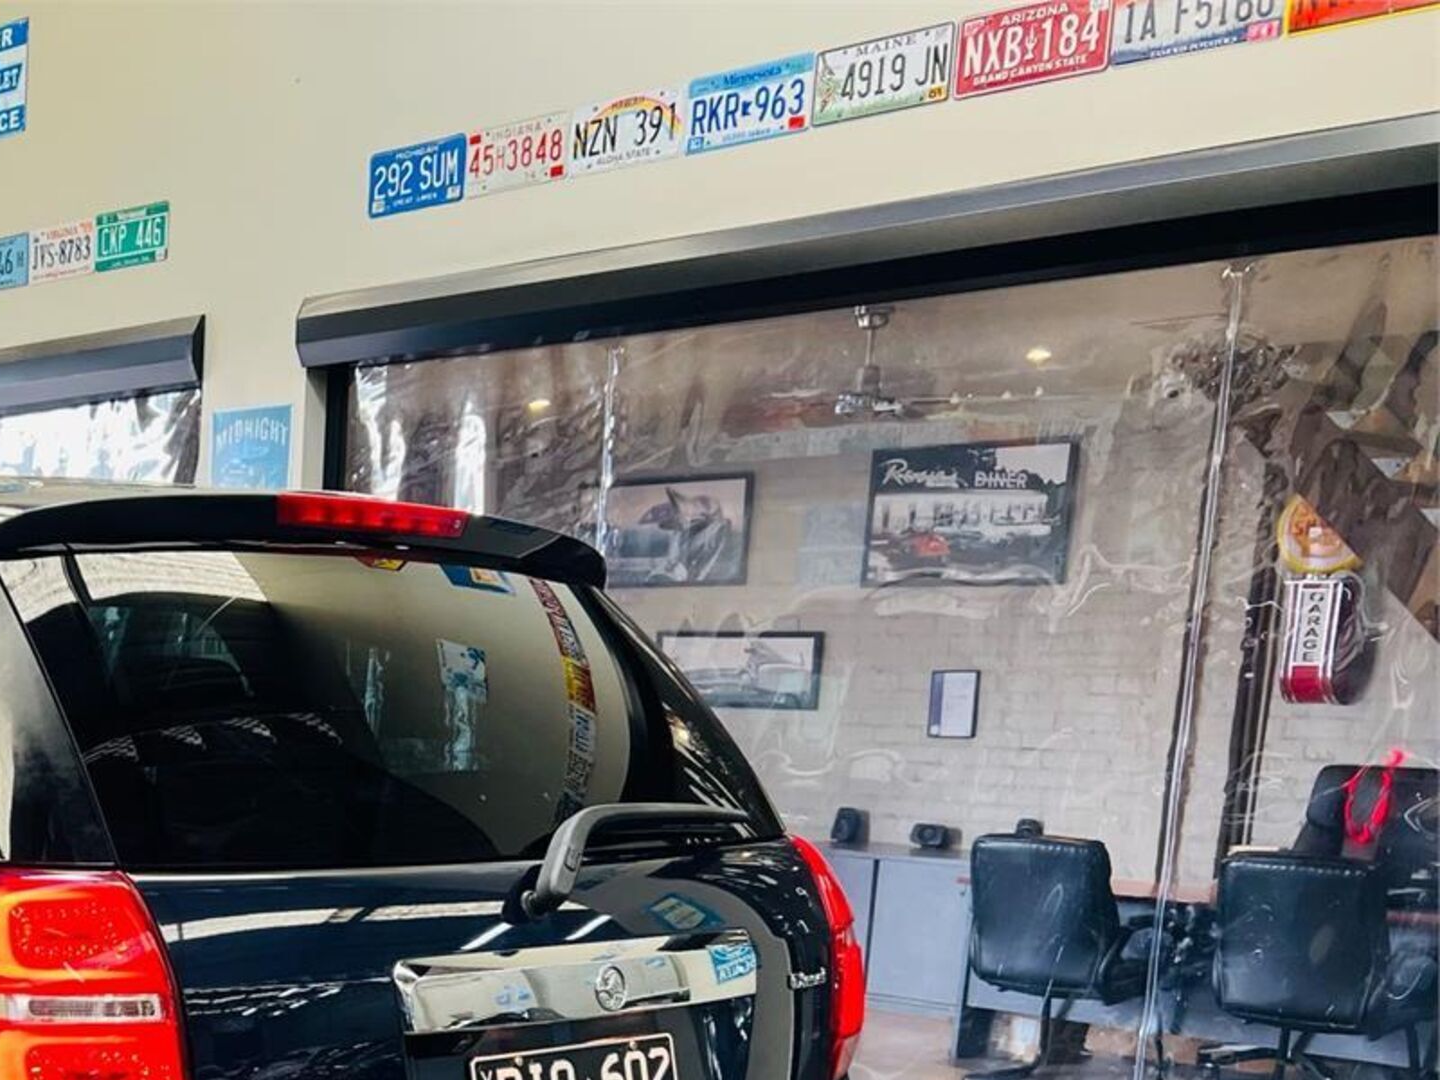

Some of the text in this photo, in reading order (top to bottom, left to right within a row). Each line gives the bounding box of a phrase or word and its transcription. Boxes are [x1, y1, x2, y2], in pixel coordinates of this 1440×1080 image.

[1000, 4, 1069, 27] ARIZONA
[855, 33, 919, 57] MAINE
[963, 12, 1100, 79] NXB 184
[723, 65, 782, 88] Minnesota
[841, 43, 948, 101] 4919 JN
[973, 54, 1087, 86] GRAND CANYON STATE
[755, 78, 805, 122] 963
[492, 122, 541, 140] INDIANA
[573, 102, 676, 160] NZN 391
[626, 147, 651, 159] STATE
[374, 148, 459, 199] 292 SUM
[135, 217, 161, 248] 446
[215, 417, 288, 448] MIDNIGHT
[974, 471, 1028, 488] DINER
[1302, 591, 1324, 661] GARAGE
